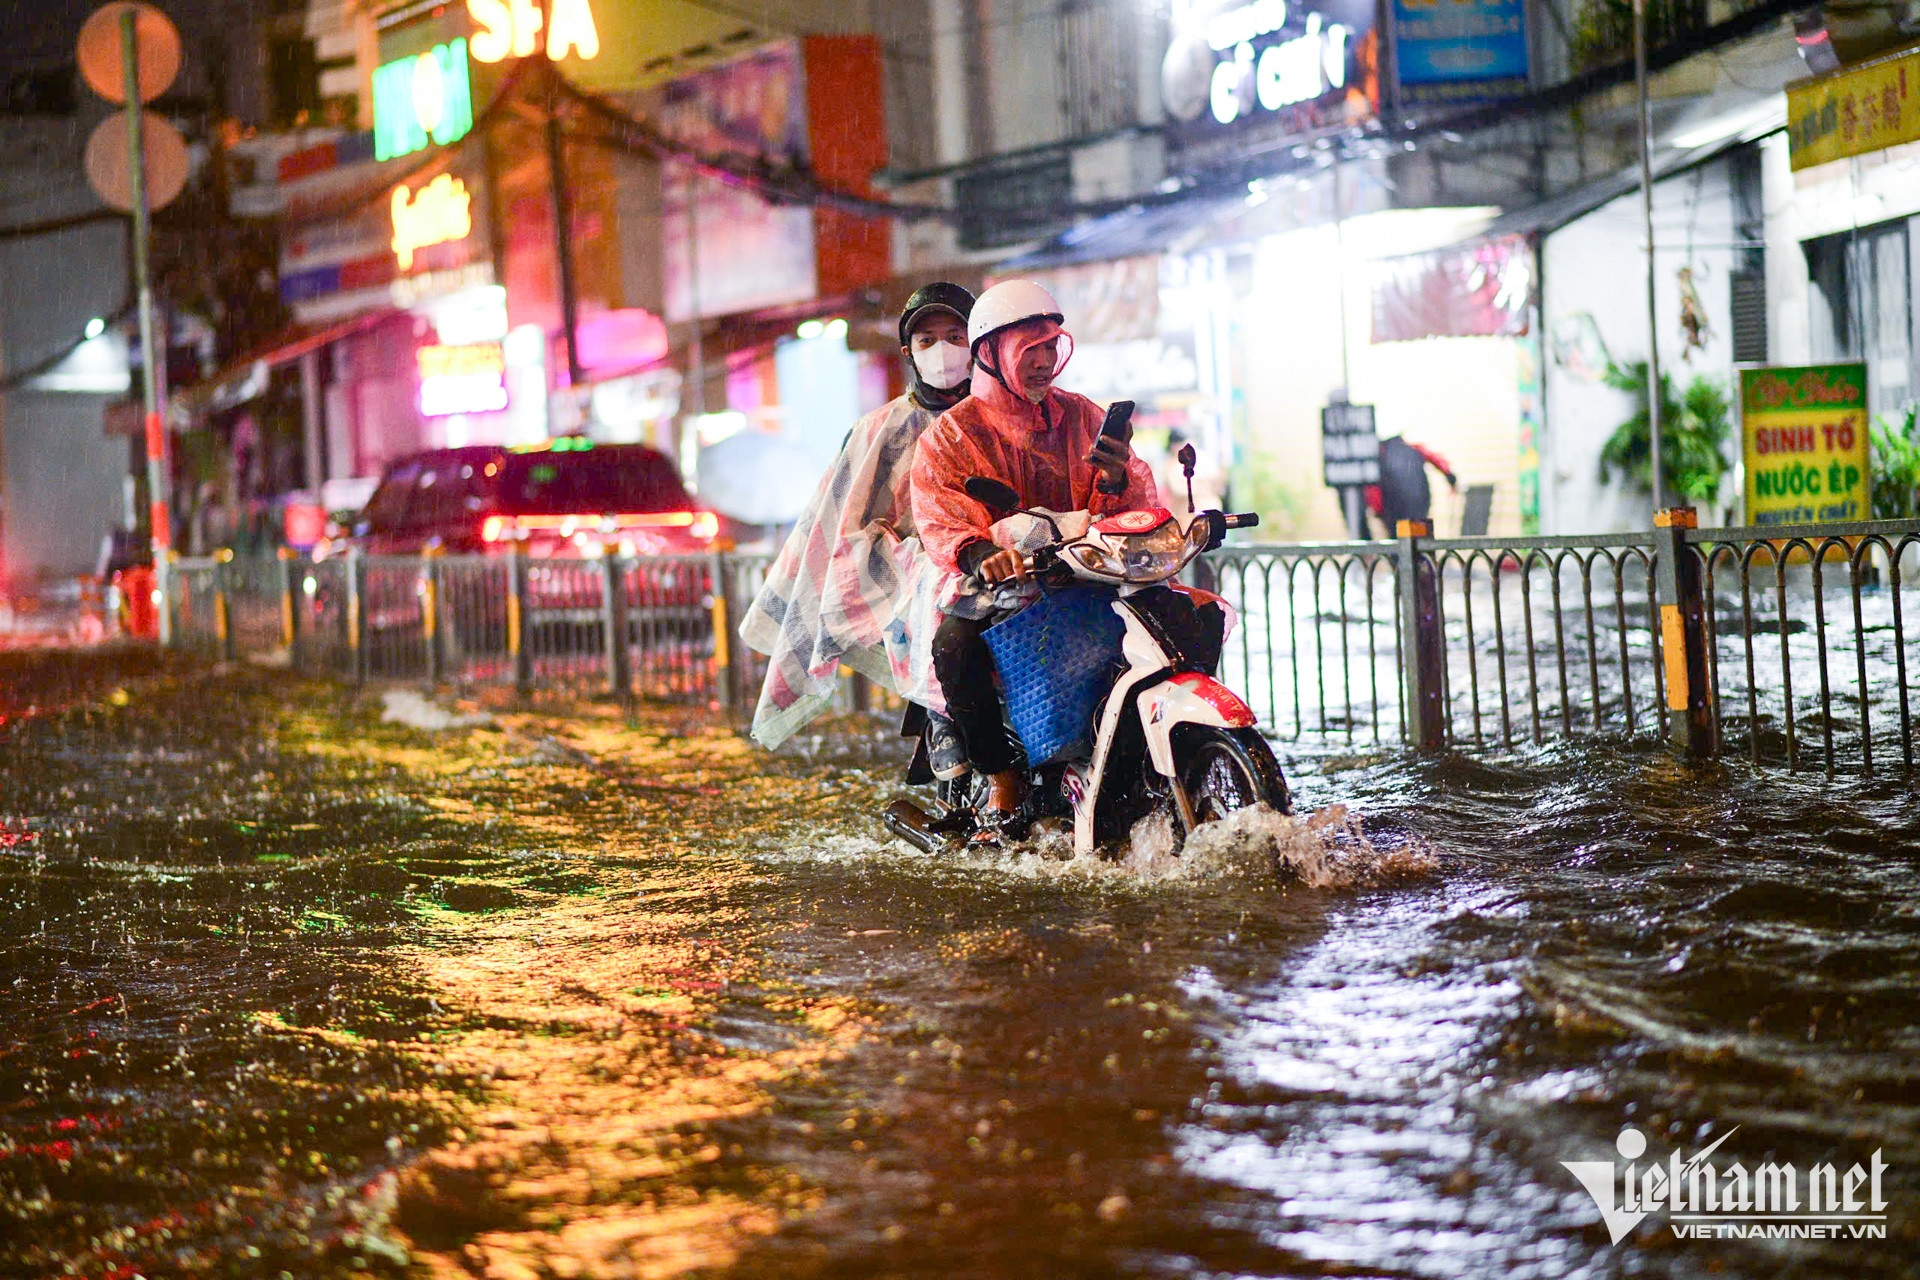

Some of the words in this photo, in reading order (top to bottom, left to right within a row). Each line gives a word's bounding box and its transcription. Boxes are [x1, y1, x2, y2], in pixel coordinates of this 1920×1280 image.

[1756, 426, 1815, 455] SINH
[1822, 415, 1858, 452] TỐ
[1755, 459, 1821, 496] NƯỚC
[1828, 459, 1860, 493] ÉP
